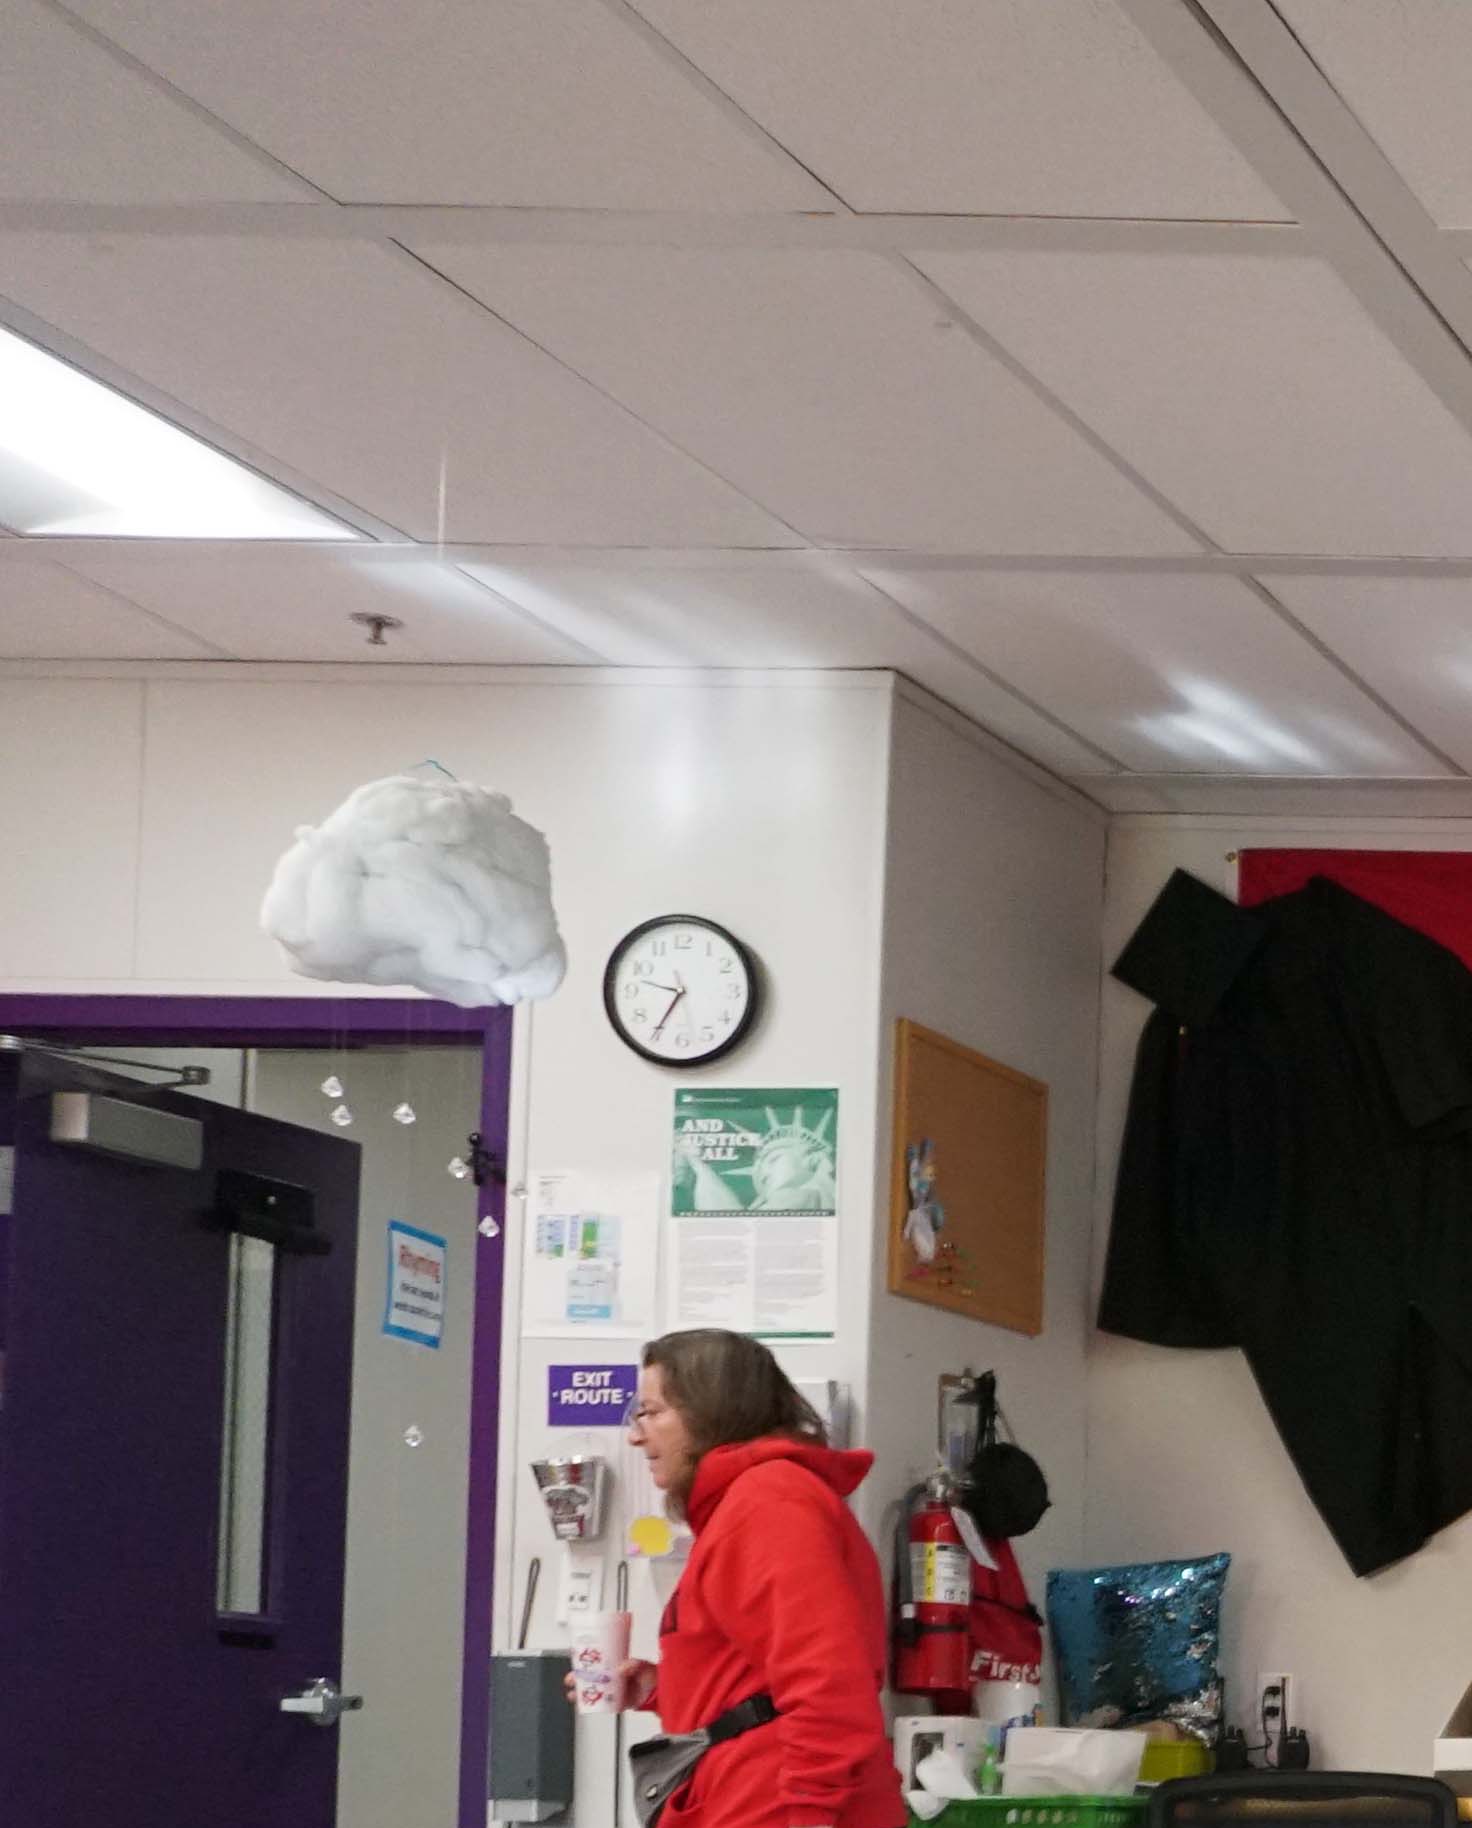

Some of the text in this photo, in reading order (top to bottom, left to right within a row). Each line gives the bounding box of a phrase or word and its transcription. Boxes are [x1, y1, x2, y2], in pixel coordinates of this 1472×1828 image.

[682, 1119, 724, 1133] AND
[703, 1148, 739, 1160] ALL
[572, 1372, 613, 1387] EXIT
[560, 1389, 624, 1405] ROUTE
[971, 1652, 1030, 1682] First
